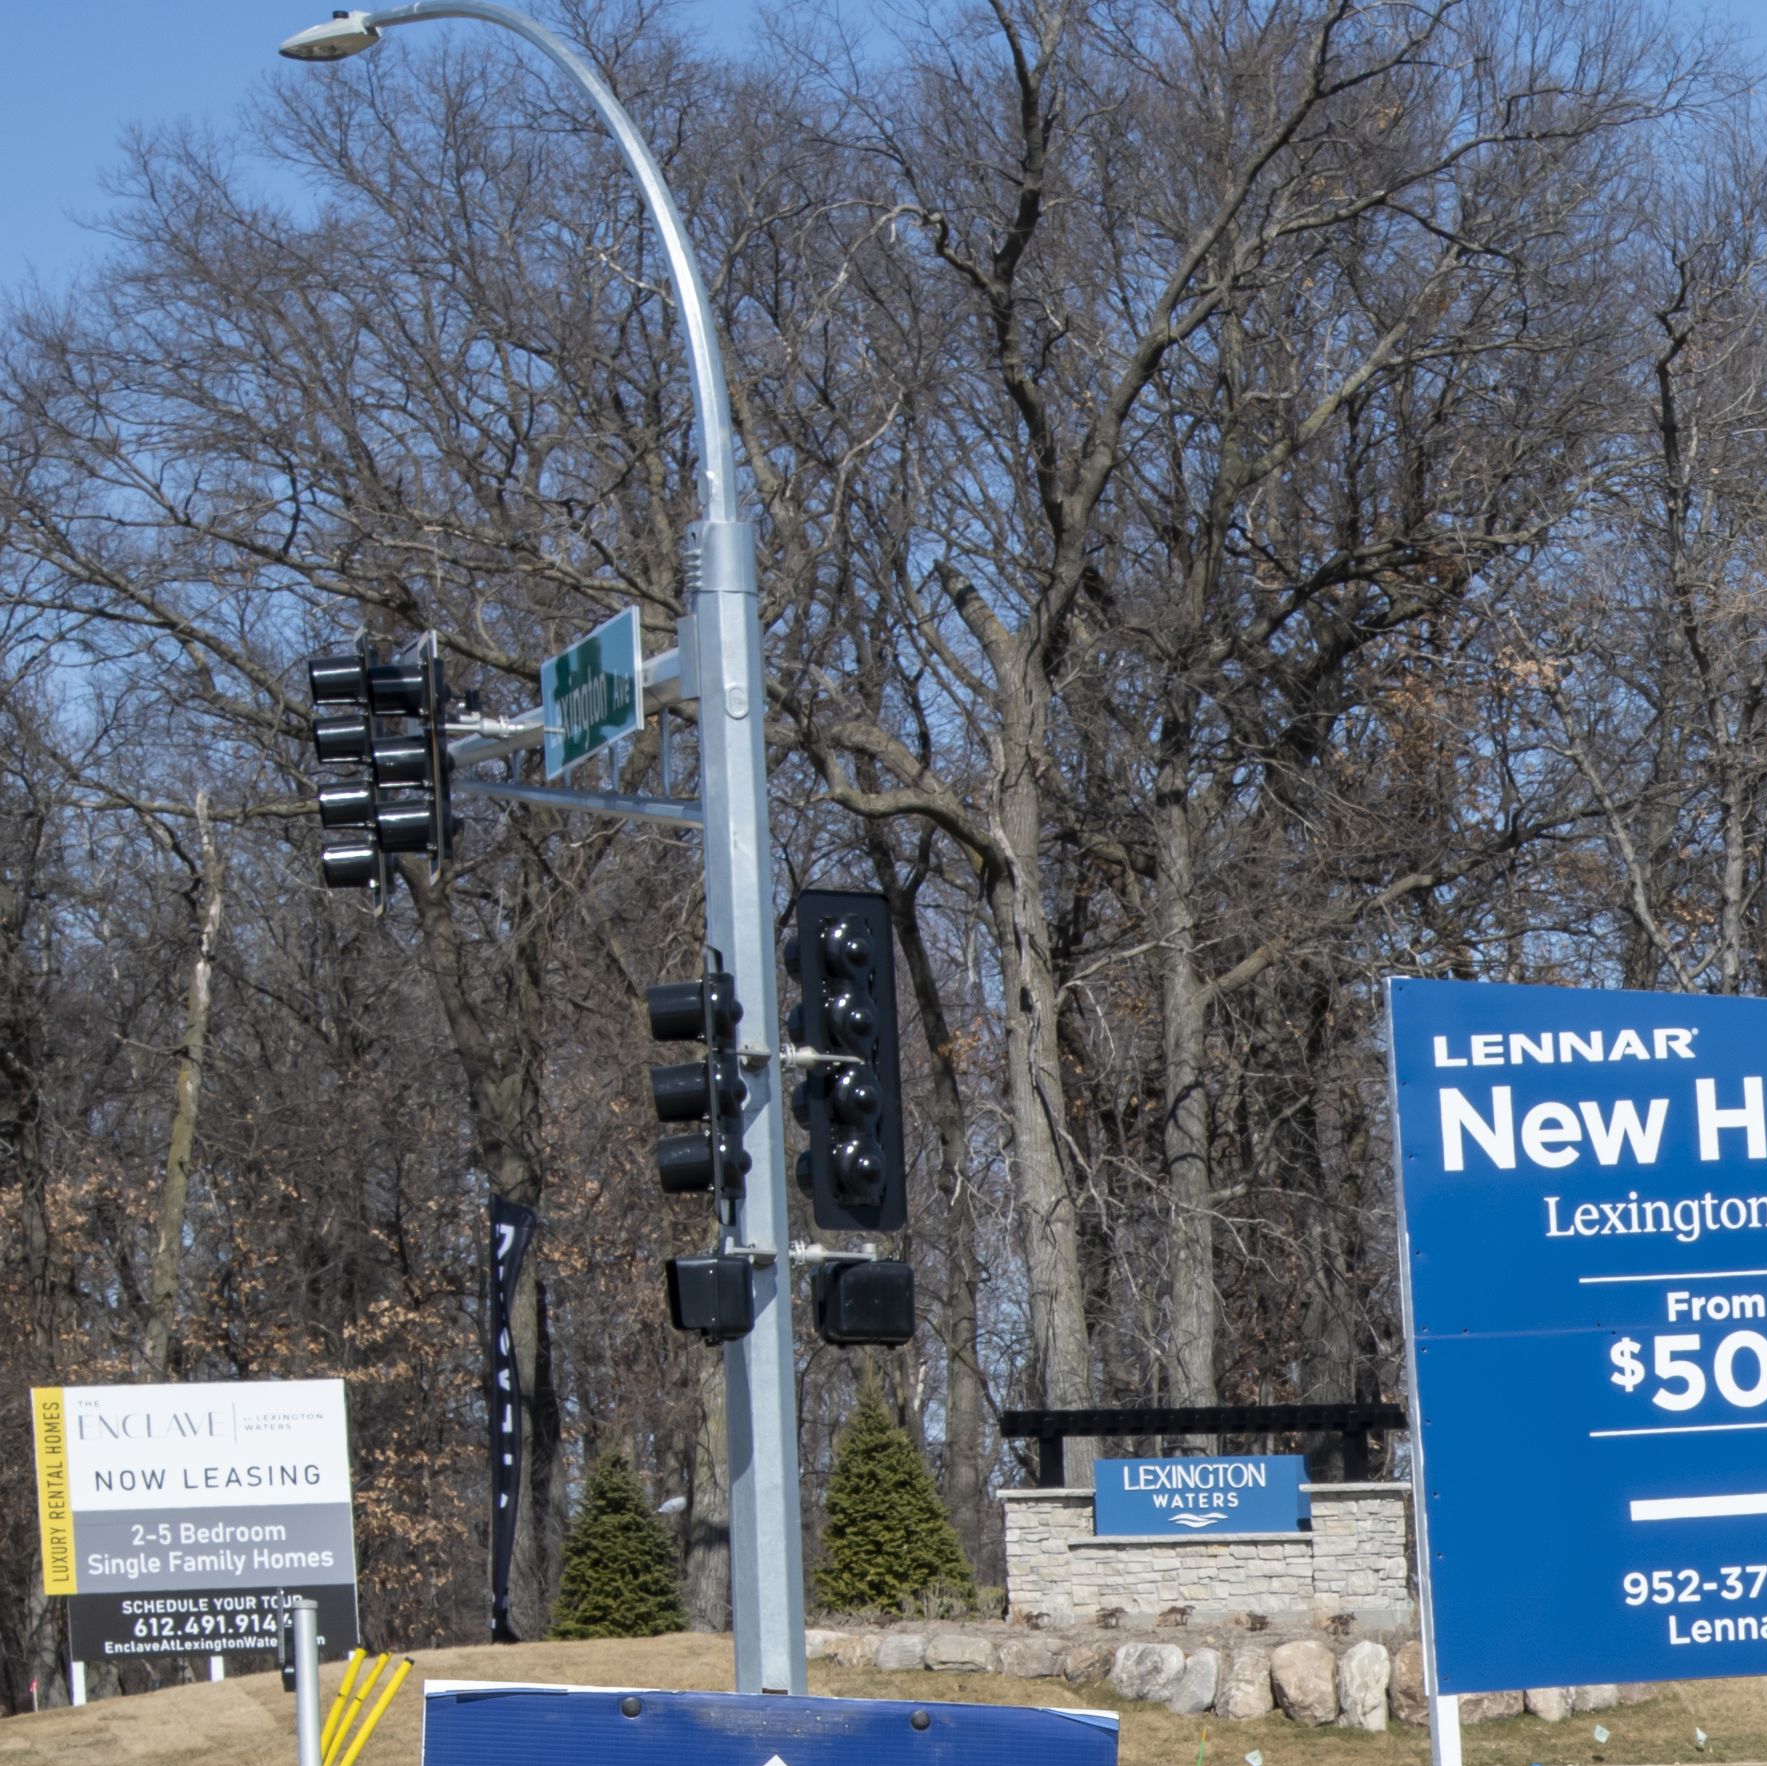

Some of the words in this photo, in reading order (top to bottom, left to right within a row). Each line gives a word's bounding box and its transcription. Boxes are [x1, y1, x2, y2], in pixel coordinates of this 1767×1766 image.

[1433, 1028, 1697, 1068] LENNAR
[1439, 1084, 1669, 1172] New
[1667, 1290, 1766, 1322] From
[42, 1401, 60, 1457] HOMES
[77, 1411, 226, 1441] ENCLAVE
[244, 1423, 292, 1432] WATERS
[256, 1413, 324, 1422] LEXINGTON
[49, 1461, 66, 1520] RENTAL
[95, 1469, 166, 1492] NOW
[183, 1464, 321, 1490] LEASING
[1123, 1462, 1266, 1491] LEXINGTON
[1153, 1492, 1239, 1509] WATERS
[131, 1524, 172, 1546] 2-5
[180, 1522, 287, 1544] Bedroom
[52, 1523, 70, 1583] LUXURY
[88, 1552, 161, 1579] Single
[168, 1550, 246, 1576] Family
[253, 1548, 335, 1570] Homes
[122, 1598, 208, 1614] SCHEDULE
[213, 1596, 256, 1611] YOUR
